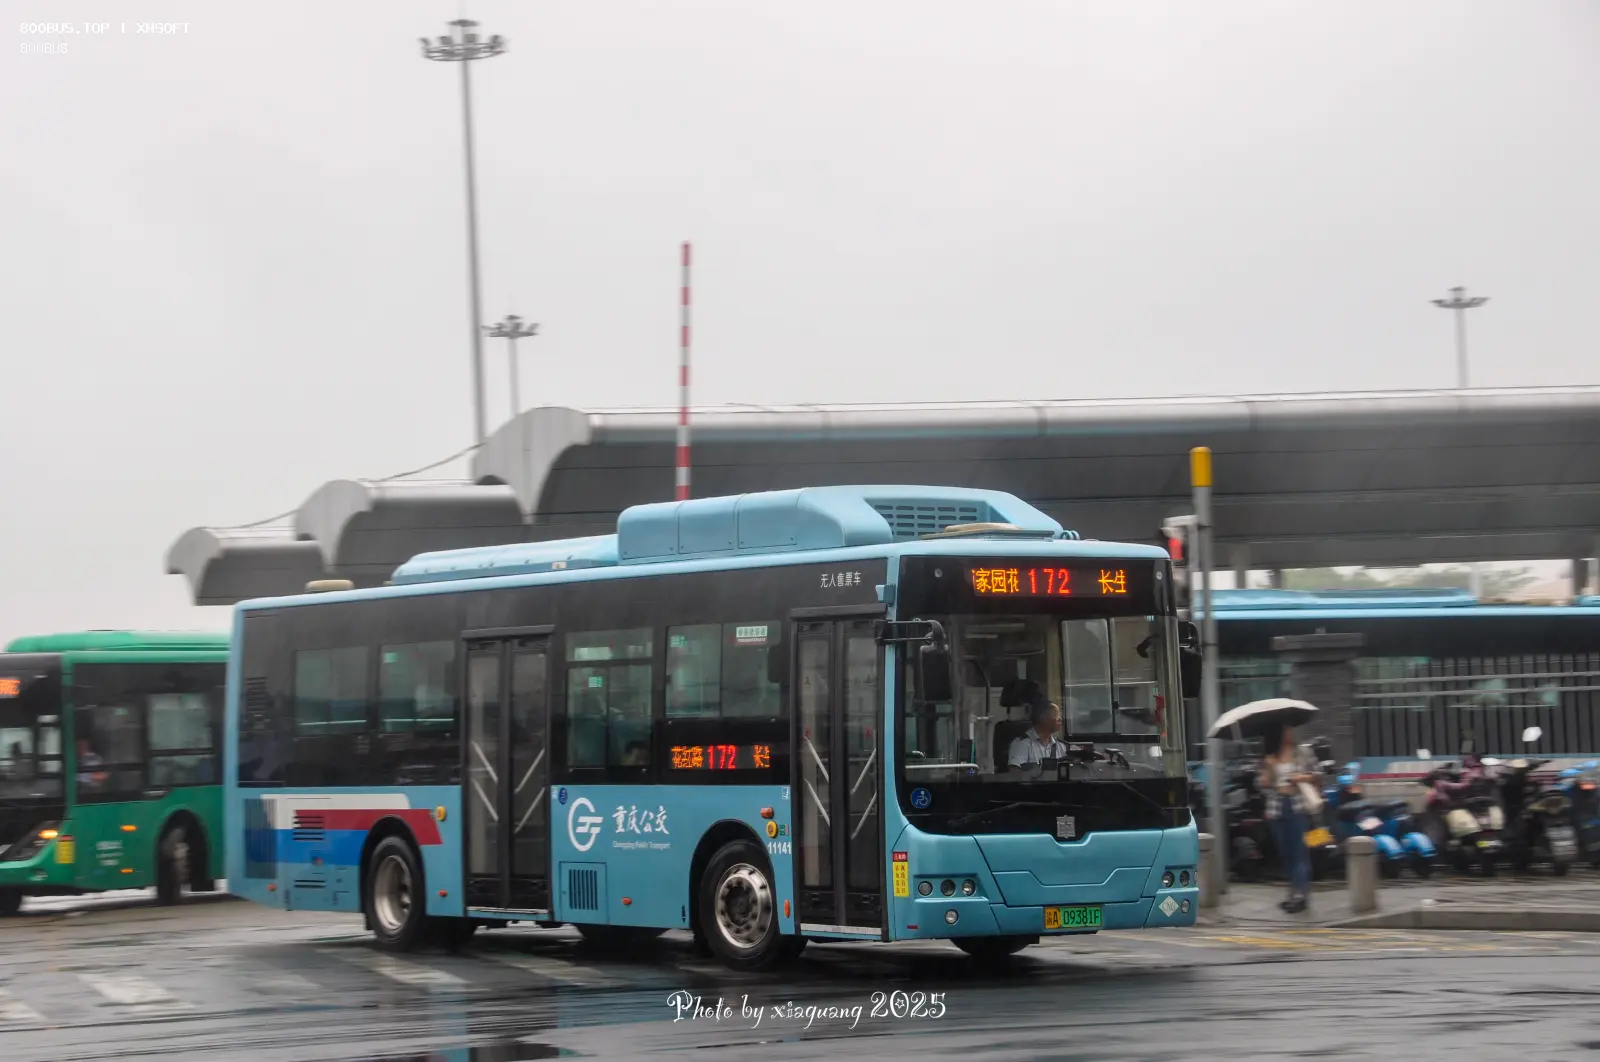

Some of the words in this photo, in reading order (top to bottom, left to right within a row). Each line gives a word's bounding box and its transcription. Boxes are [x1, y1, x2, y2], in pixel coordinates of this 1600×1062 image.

[820, 571, 862, 588] 无人售票车
[972, 568, 1019, 593] 家园花
[1028, 568, 1071, 594] 172
[1098, 569, 1127, 594] 长生
[707, 744, 737, 769] 172
[612, 805, 670, 834] 重庆公交
[768, 841, 792, 854] 11141
